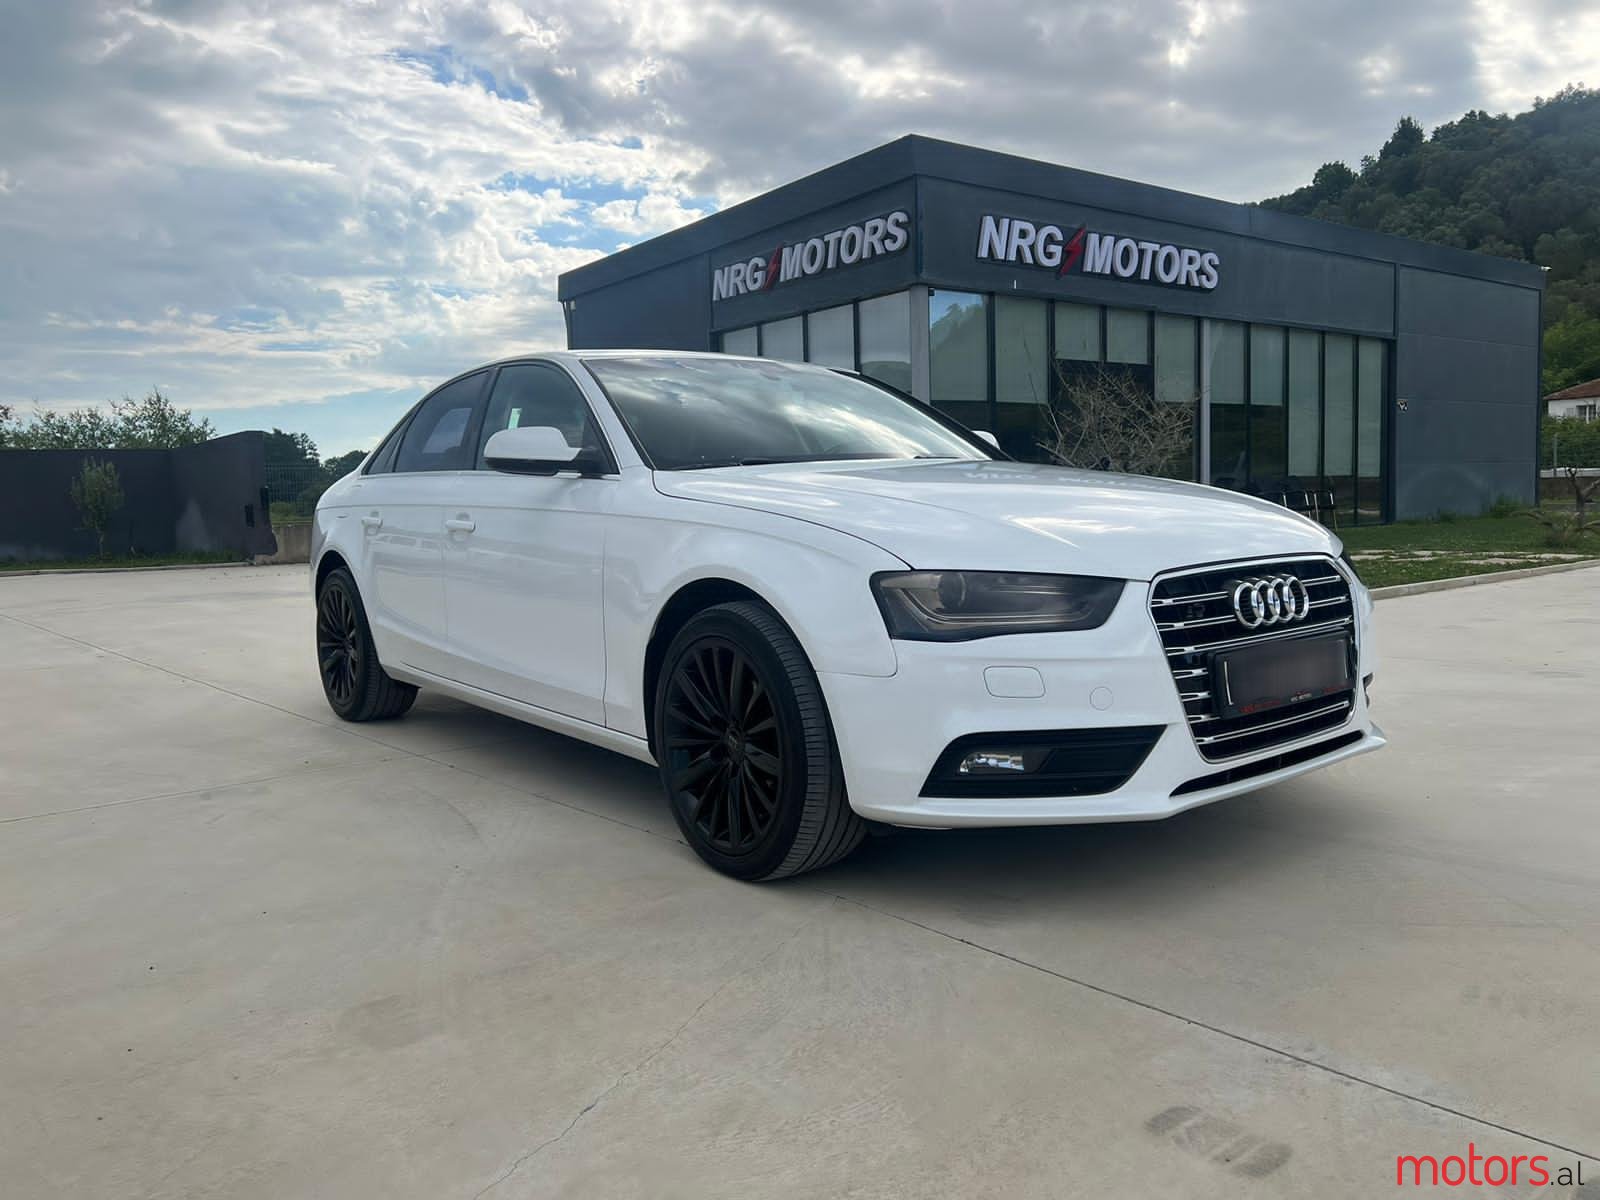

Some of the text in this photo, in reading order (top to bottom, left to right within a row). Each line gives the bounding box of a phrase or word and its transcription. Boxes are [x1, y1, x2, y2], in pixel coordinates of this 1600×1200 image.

[713, 211, 909, 301] NRG MOTORS
[977, 215, 1220, 289] NRG MOTORS
